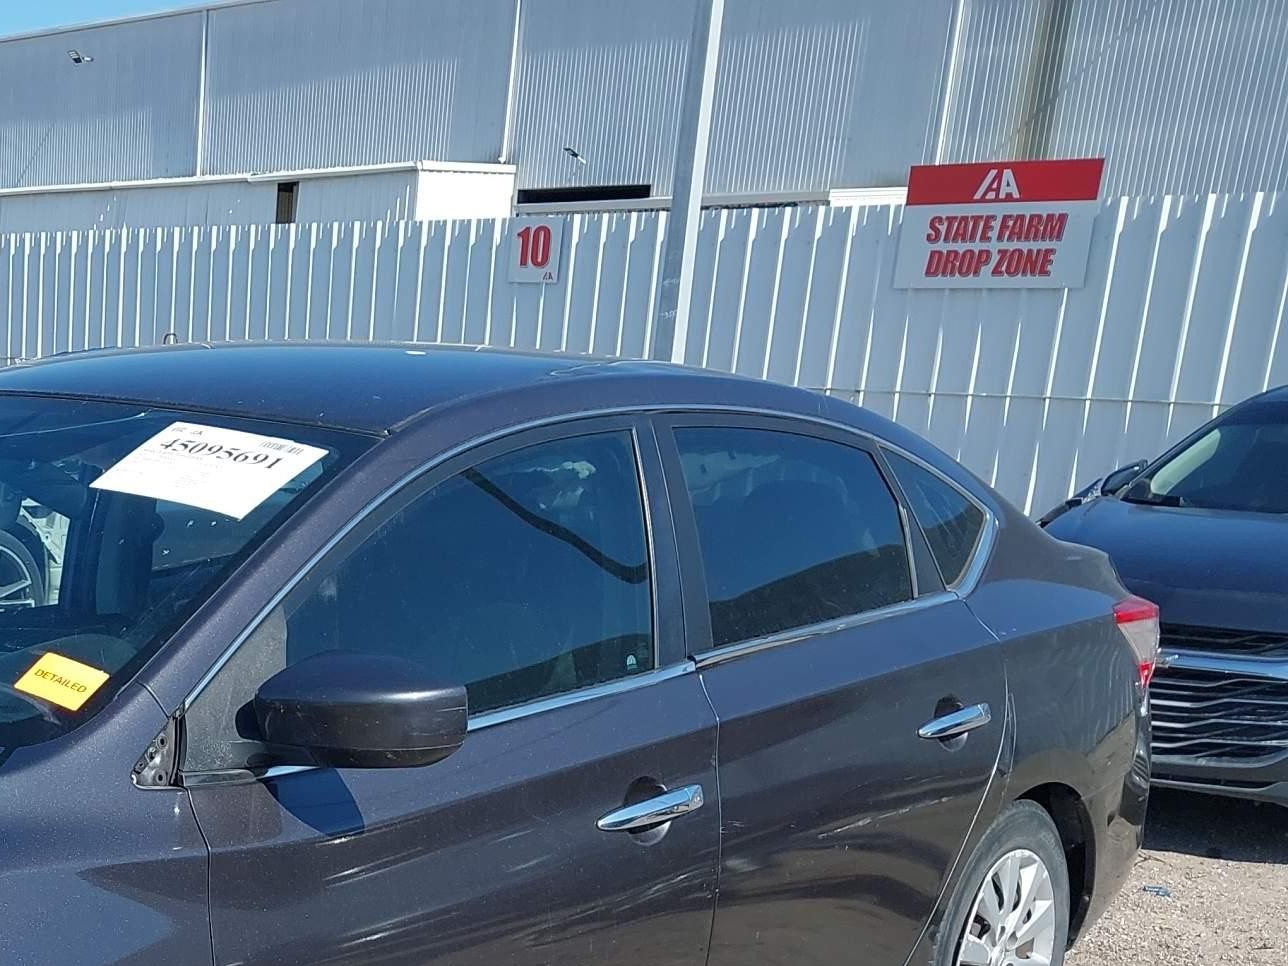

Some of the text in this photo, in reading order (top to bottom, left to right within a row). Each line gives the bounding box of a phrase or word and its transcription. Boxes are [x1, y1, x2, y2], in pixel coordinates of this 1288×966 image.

[926, 213, 1068, 244] STATE FARM
[517, 226, 551, 267] 10
[924, 248, 1057, 277] DROP ZONE
[160, 437, 283, 469] 45095691
[34, 668, 87, 693] DETAILED
